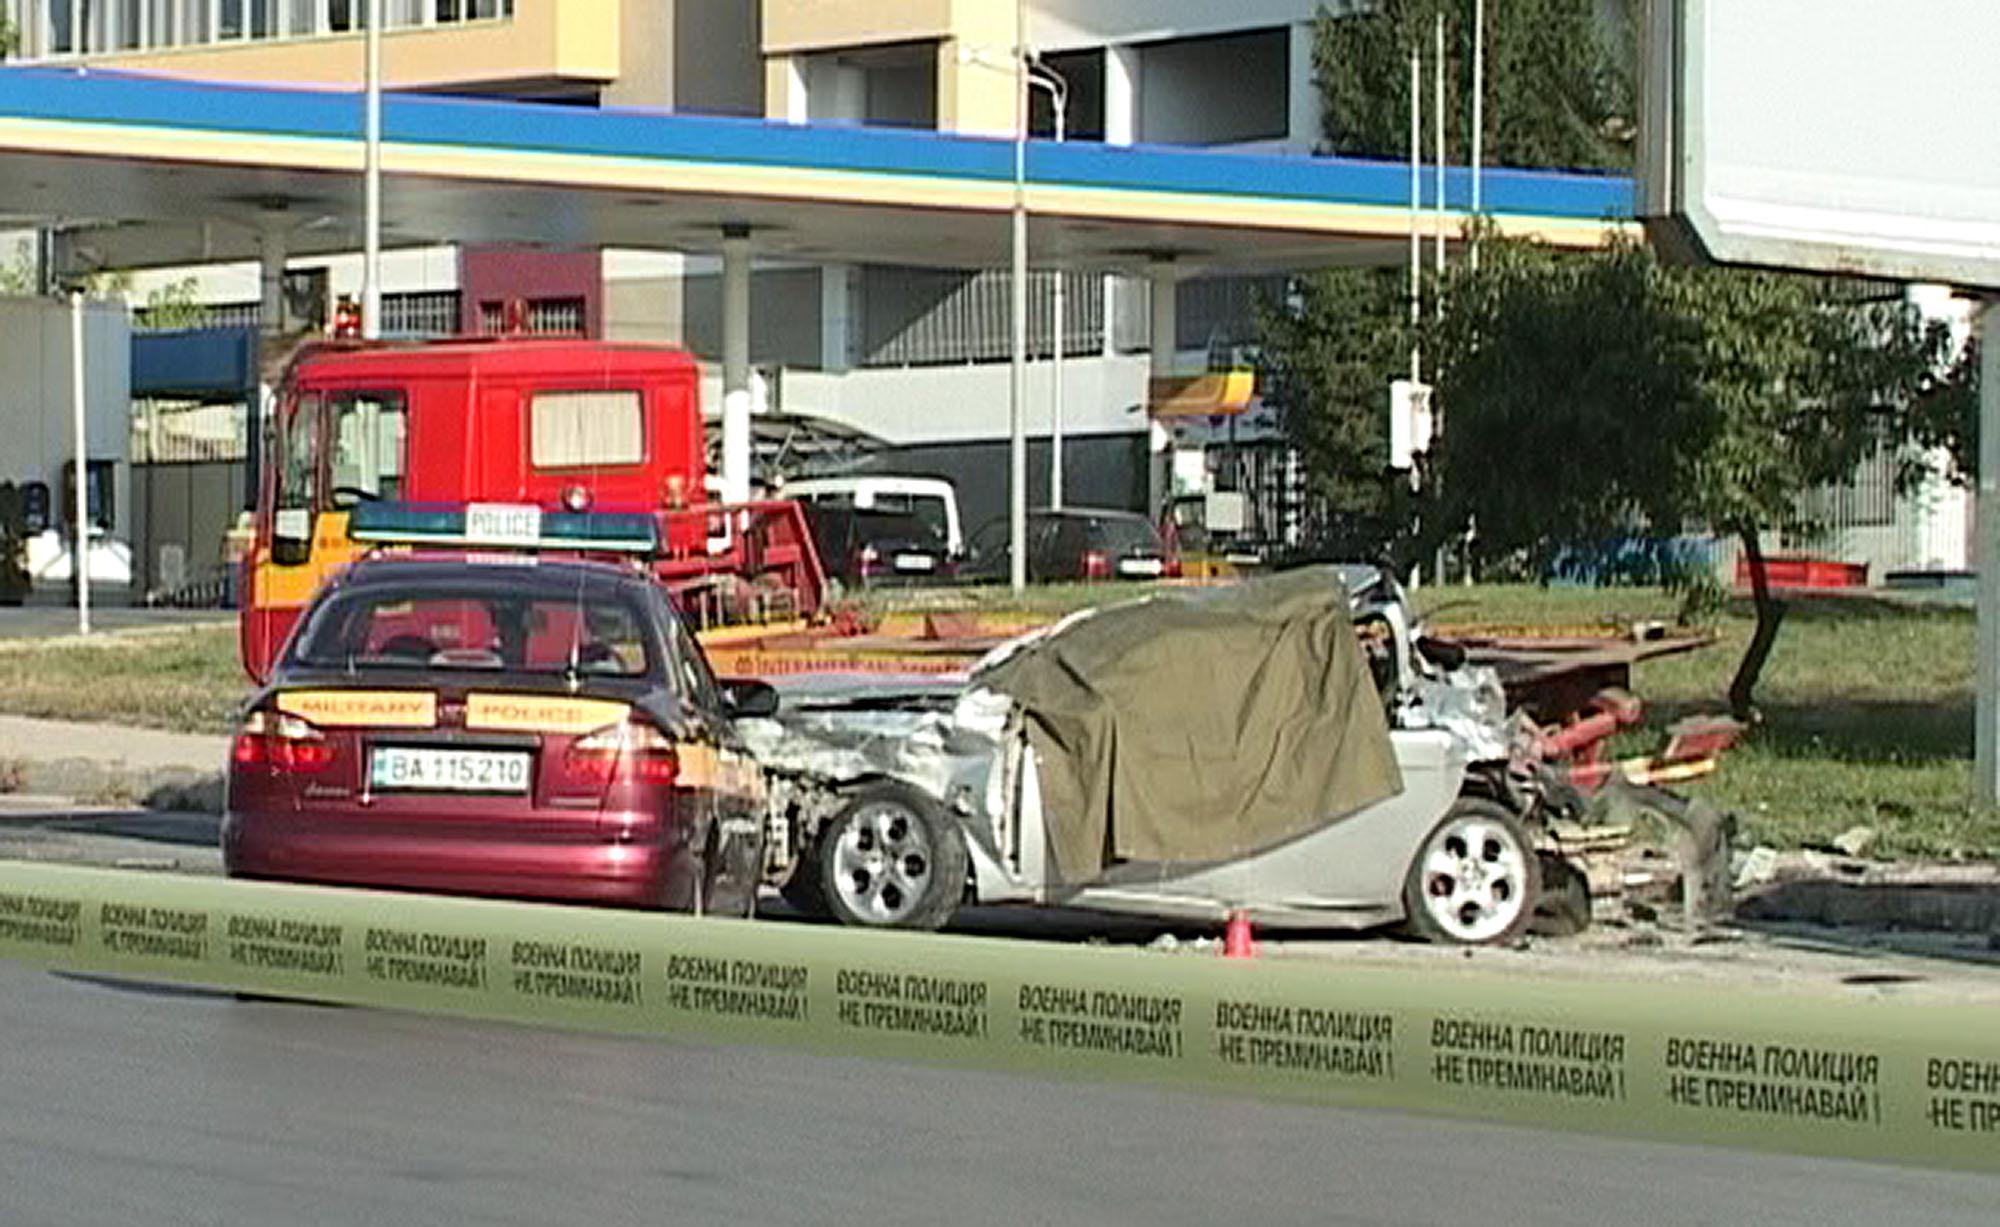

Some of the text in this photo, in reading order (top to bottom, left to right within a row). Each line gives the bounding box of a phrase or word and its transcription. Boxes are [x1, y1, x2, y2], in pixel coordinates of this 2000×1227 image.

[472, 511, 534, 537] POLICE
[302, 701, 422, 714] MILITARY
[482, 704, 584, 721] POLICE
[434, 756, 522, 783] 115210
[1019, 984, 1181, 1024] ВОЕННА ПОЛИЦИЯ
[1216, 1001, 1393, 1043] ВОЕННА ПОЛИЦИЯ
[1431, 1018, 1625, 1065] ВОЕННА ПОЛИЦИЯ
[1666, 1038, 1878, 1086] ВОЕННА ПОЛИЦИЯ
